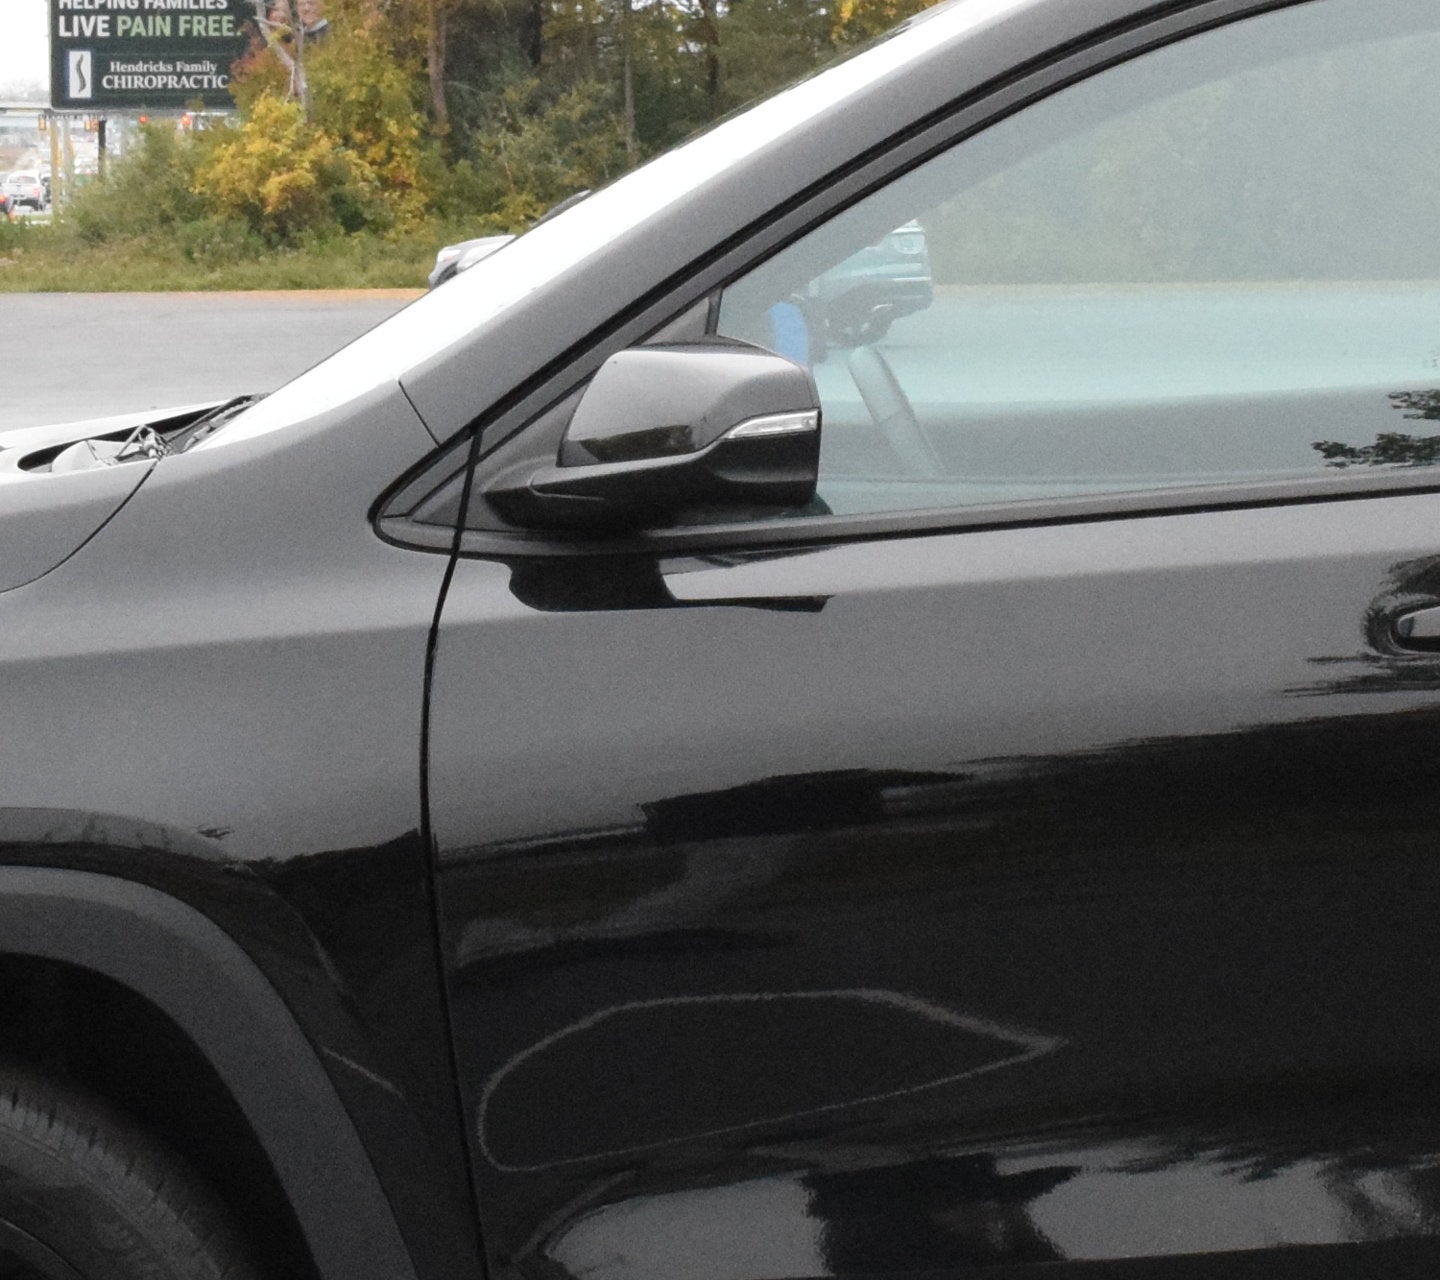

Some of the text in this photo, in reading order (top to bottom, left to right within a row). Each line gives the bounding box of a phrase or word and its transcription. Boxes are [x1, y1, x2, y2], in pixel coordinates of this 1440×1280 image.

[59, 15, 243, 37] LIVE PAIN FREE.
[109, 61, 218, 76] Hendricks Family
[102, 74, 229, 89] CHIROPRACTIC
